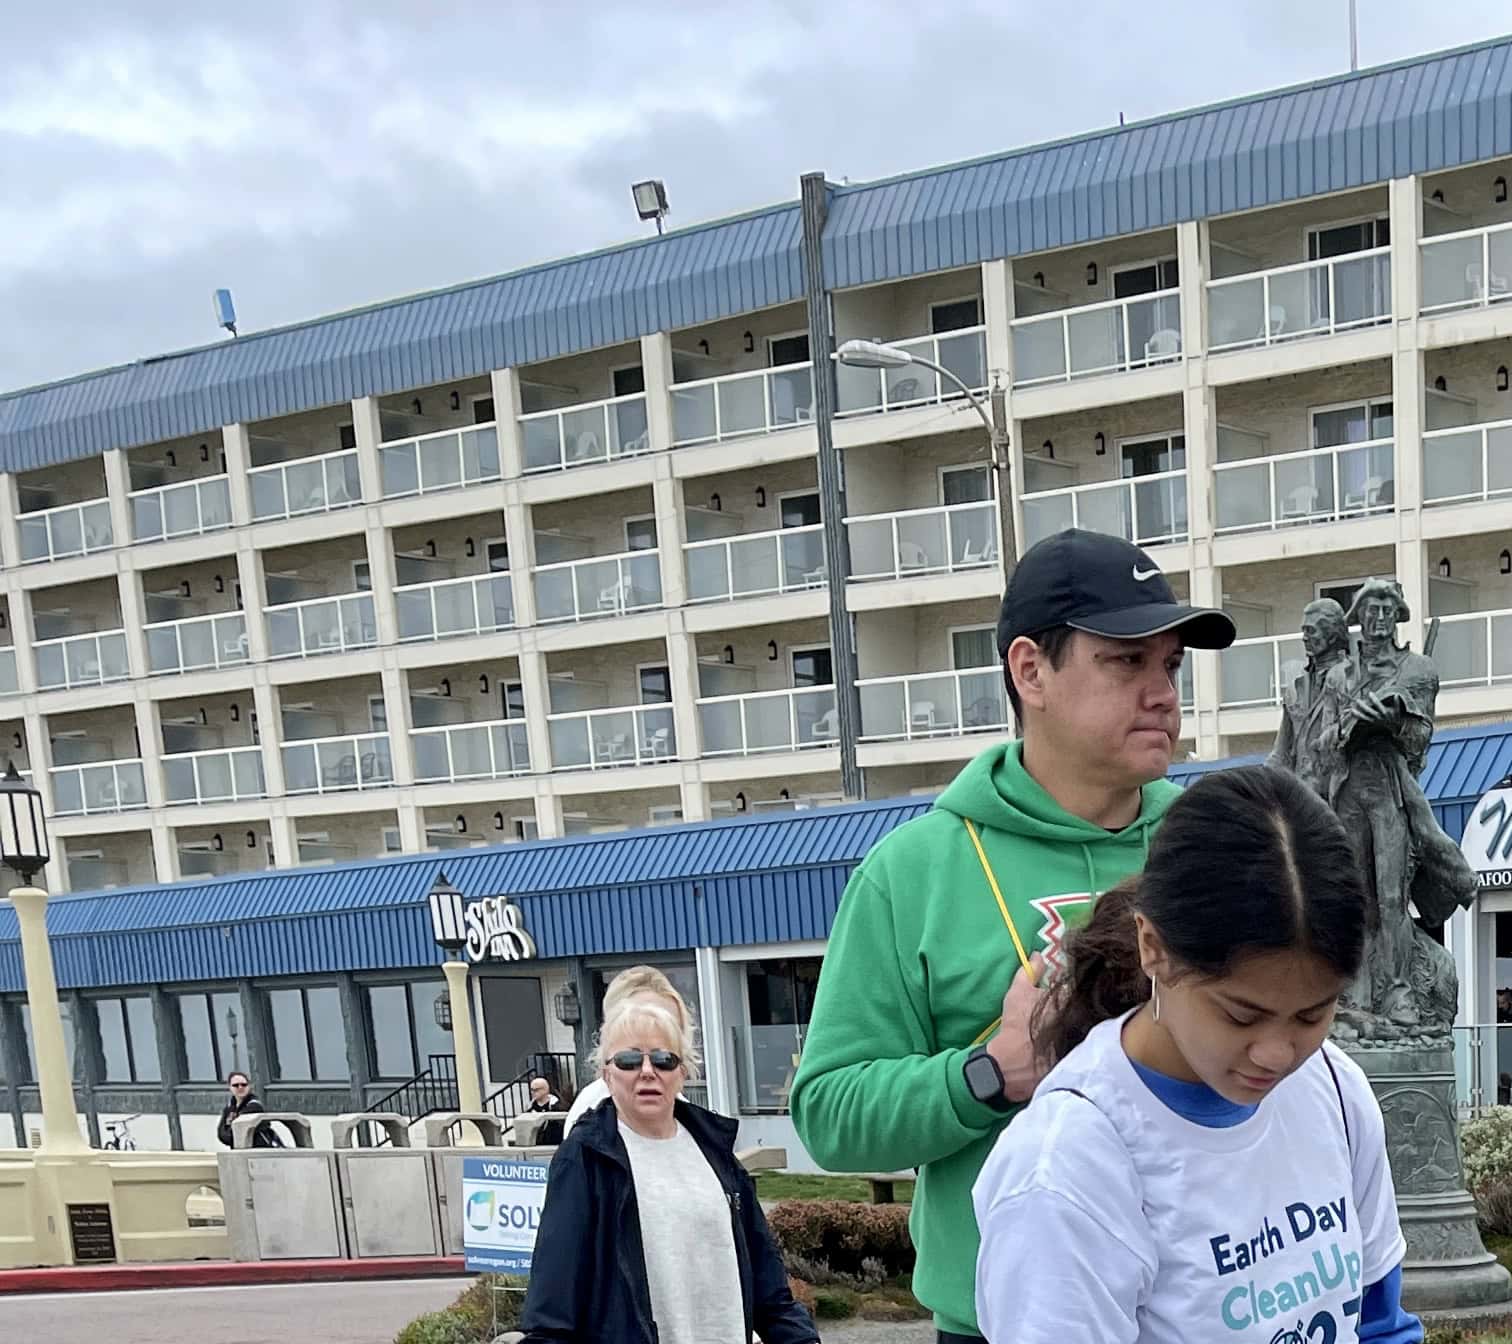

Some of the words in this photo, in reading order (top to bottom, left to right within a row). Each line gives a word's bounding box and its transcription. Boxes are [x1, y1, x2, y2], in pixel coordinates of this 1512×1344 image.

[483, 1164, 547, 1180] VOLUNTEER
[1209, 1216, 1285, 1276] Earth
[1285, 1196, 1347, 1242] Day
[1221, 1243, 1361, 1330] CleanUp
